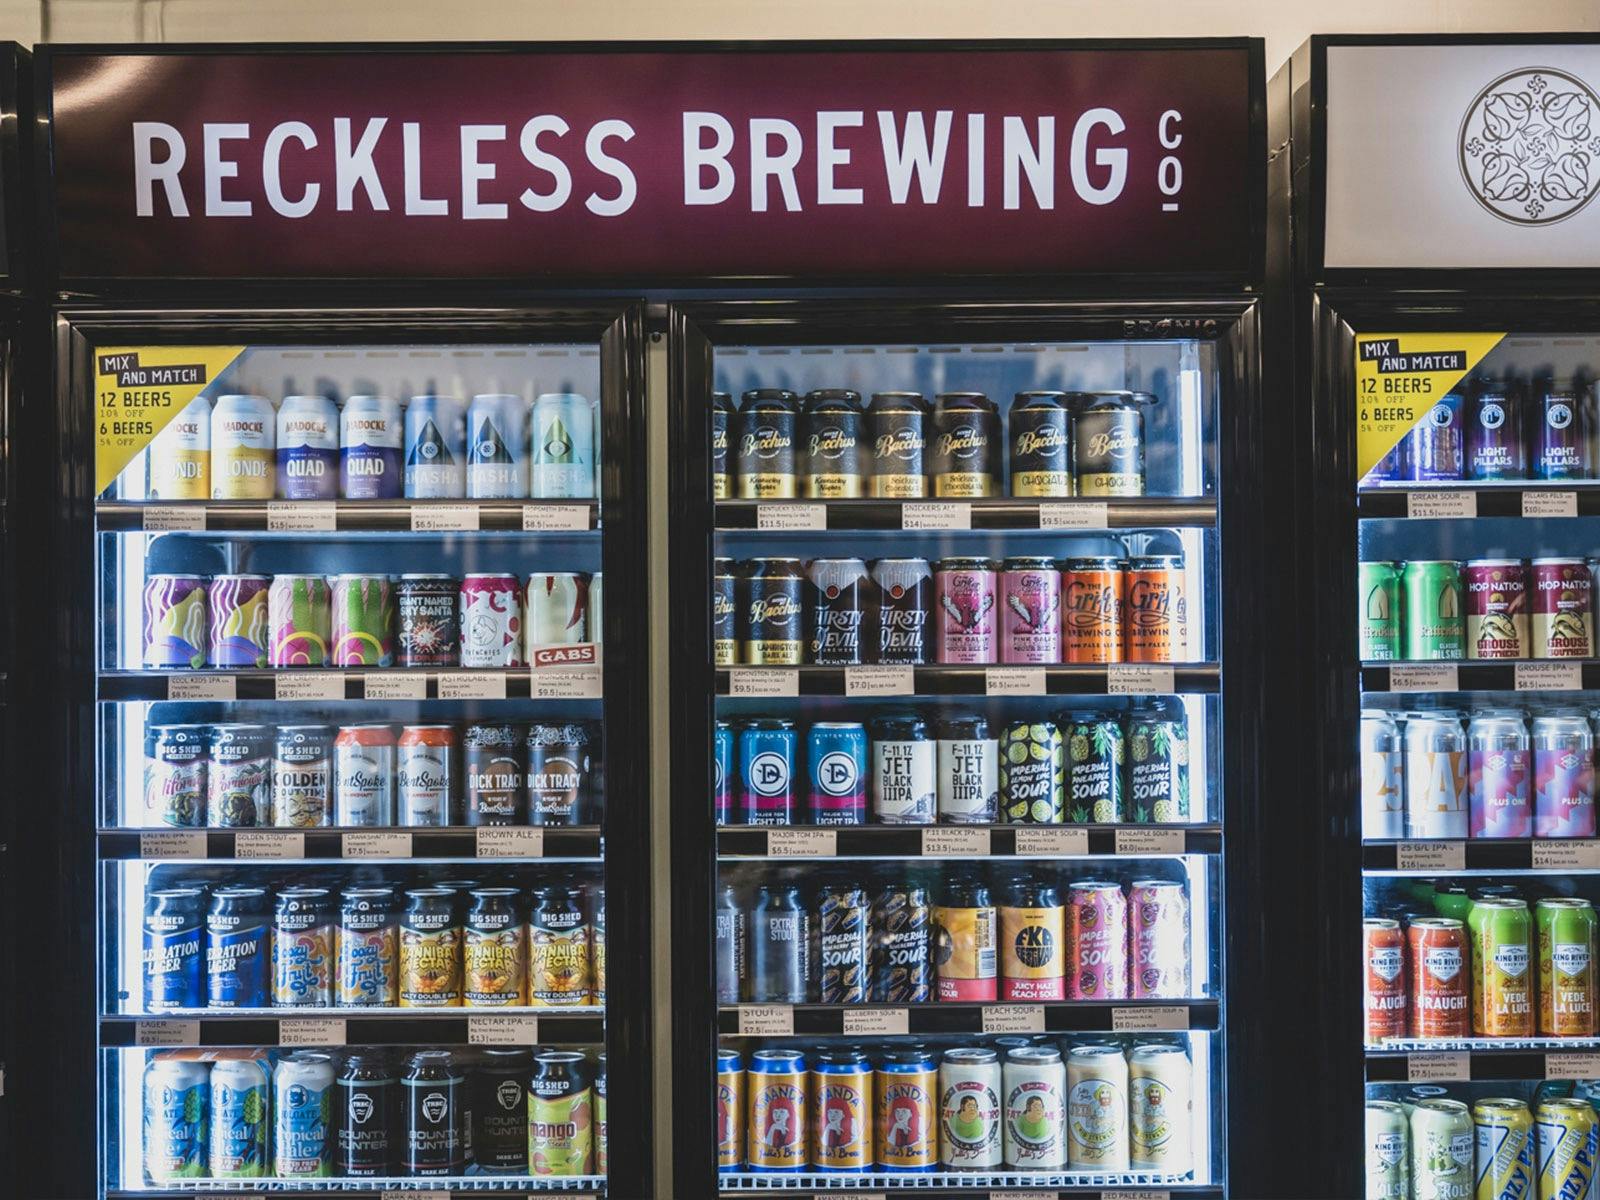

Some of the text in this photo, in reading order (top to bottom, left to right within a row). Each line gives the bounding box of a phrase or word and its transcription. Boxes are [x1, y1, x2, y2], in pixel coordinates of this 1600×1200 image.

[133, 107, 1128, 219] RECKLESS BREWING
[1365, 343, 1391, 357] MIX
[104, 356, 130, 372] MIX
[1382, 355, 1458, 371] AND MATCH
[121, 369, 198, 385] AND MATCH
[1361, 378, 1432, 394] 12 BEERS
[101, 392, 172, 407] 12 BEERS
[1361, 395, 1405, 404] 10% OFF
[101, 409, 144, 418] 10% OFF
[1361, 408, 1414, 421] 6 BEERS
[101, 422, 153, 435] 6 BEERS
[1377, 424, 1396, 432] OFF
[117, 438, 136, 446] OFF
[740, 431, 792, 457] Bacchus
[808, 431, 857, 456] Bacchus
[875, 432, 926, 458] Bacchus
[937, 430, 988, 457] Bacchus
[1016, 431, 1069, 457] Bacchus
[1478, 447, 1507, 457] LIGHT
[1545, 447, 1574, 457] LIGHT
[1473, 456, 1512, 466] PILLARS
[1541, 456, 1580, 466] PILLARS
[285, 459, 325, 477] QUAD
[347, 459, 385, 476] QUAD
[1469, 581, 1523, 592] HOP NATION
[1538, 579, 1592, 591] HOP NATION
[399, 597, 454, 606] GIANT NAKED
[420, 606, 453, 615] SANTA
[750, 597, 802, 625] Bacchus
[881, 627, 923, 650] DEVIL
[1477, 639, 1519, 649] GROUSE
[1547, 638, 1588, 648] GROUSE
[538, 647, 592, 663] GABS
[1518, 663, 1567, 671] GROUSE IPA
[178, 745, 202, 753] SHED
[222, 745, 249, 754] SHED
[297, 746, 321, 754] SHED
[883, 758, 912, 775] JET
[953, 757, 983, 774] JET
[1010, 762, 1050, 775] IMPERIAL
[1072, 761, 1110, 775] IMPERIAL
[1133, 761, 1170, 775] IMPERIAL
[273, 773, 326, 787] GOLDEN
[469, 774, 496, 789] DICK
[527, 773, 582, 789] DICK TRACY
[883, 775, 913, 786] BLACK
[953, 774, 983, 785] BLACK
[883, 787, 913, 801] IIIPA
[953, 786, 983, 800] IIIPA
[1011, 780, 1049, 799] SOUR
[1072, 781, 1110, 800] SOUR
[1133, 781, 1170, 800] SOUR
[1488, 798, 1510, 806] PLUS
[1562, 797, 1582, 806] PLUS
[478, 829, 534, 839] BROWN ALE
[479, 847, 496, 856] $7.0
[160, 916, 184, 924] SHED
[218, 916, 240, 924] SHED
[289, 913, 315, 922] SHED
[359, 914, 385, 923] SHED
[409, 914, 450, 923] BIG SHED
[470, 914, 509, 923] BIG SHED
[541, 913, 581, 922] BIG SHED
[770, 918, 798, 930] EXTRA
[822, 931, 862, 944] IMPERIAL
[823, 949, 862, 967] SOUR
[889, 947, 928, 965] SOUR
[1426, 957, 1462, 965] KING RIVER
[1495, 954, 1512, 962] KING
[1552, 953, 1570, 961] KING
[148, 958, 181, 975] LAGER
[207, 957, 236, 974] LAGER
[1014, 983, 1035, 991] JUICY
[1011, 990, 1059, 998] PEACH SOUR
[1503, 992, 1526, 1003] VEDE
[1561, 991, 1584, 1002] VEDE
[1418, 995, 1467, 1010] DRAUGHT
[1496, 1003, 1530, 1013] LA LUCE
[1554, 1002, 1590, 1012] LA LUCE
[743, 1009, 775, 1017] STOUT
[1013, 1006, 1035, 1014] SOUR
[470, 1017, 523, 1025] NECTAR IPA
[985, 1024, 1001, 1032] $9.0
[281, 1034, 299, 1043] $9.0
[470, 1034, 486, 1042] $13
[532, 1081, 570, 1090] BIG SHED
[338, 1130, 387, 1140] BOUNTY
[409, 1129, 459, 1140] BOUNTY
[528, 1121, 577, 1142] mango
[338, 1140, 388, 1150] HUNTER
[409, 1139, 460, 1149] HUNTER
[1375, 1142, 1391, 1150] KING
[383, 1192, 422, 1200] DARK ALE
